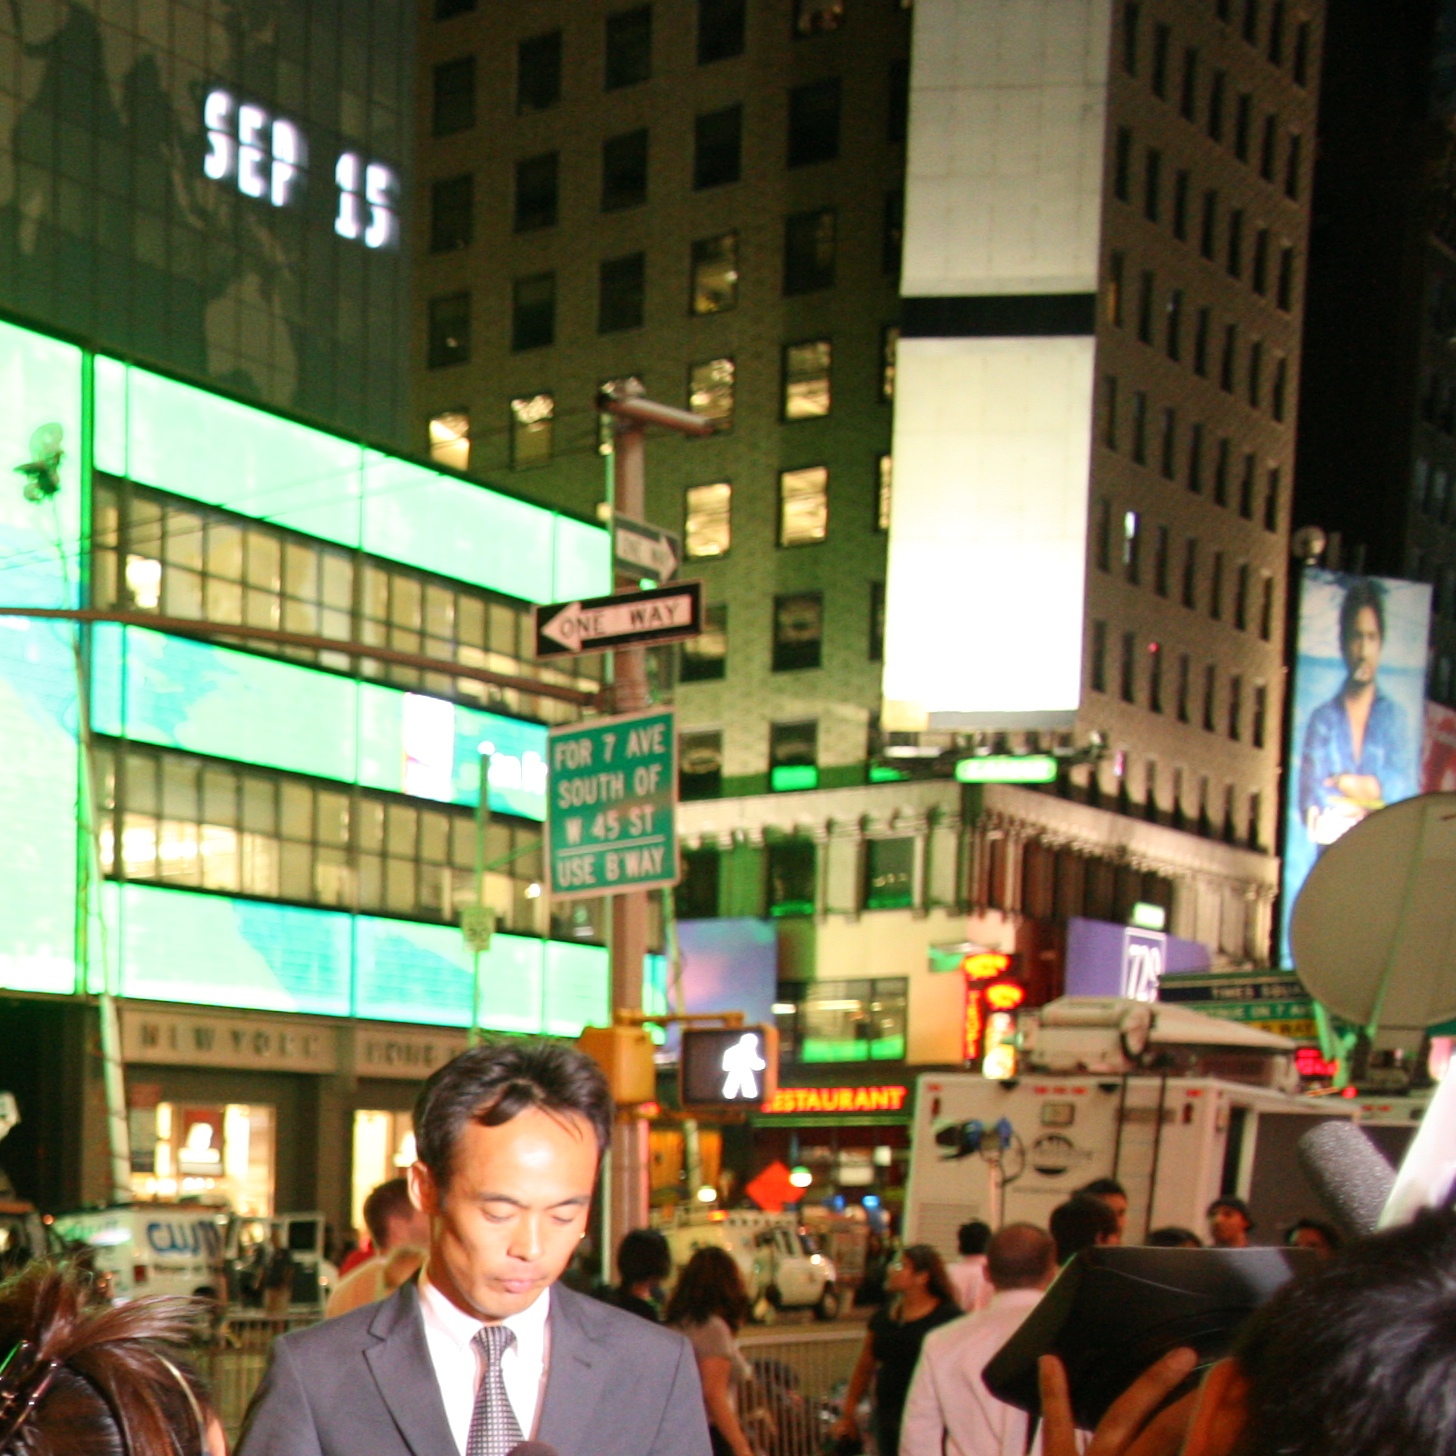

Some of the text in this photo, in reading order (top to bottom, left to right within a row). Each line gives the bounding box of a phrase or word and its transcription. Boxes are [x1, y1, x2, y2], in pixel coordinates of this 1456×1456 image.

[203, 89, 396, 249] SEP 15
[559, 601, 680, 639] ONE WAY
[554, 722, 667, 771] FOR 7 AVE
[557, 770, 625, 809] SOUTH
[633, 763, 663, 797] OF
[564, 803, 656, 846] W 45 ST
[556, 845, 666, 888] USE B'WAY
[141, 1021, 216, 1052] NEW
